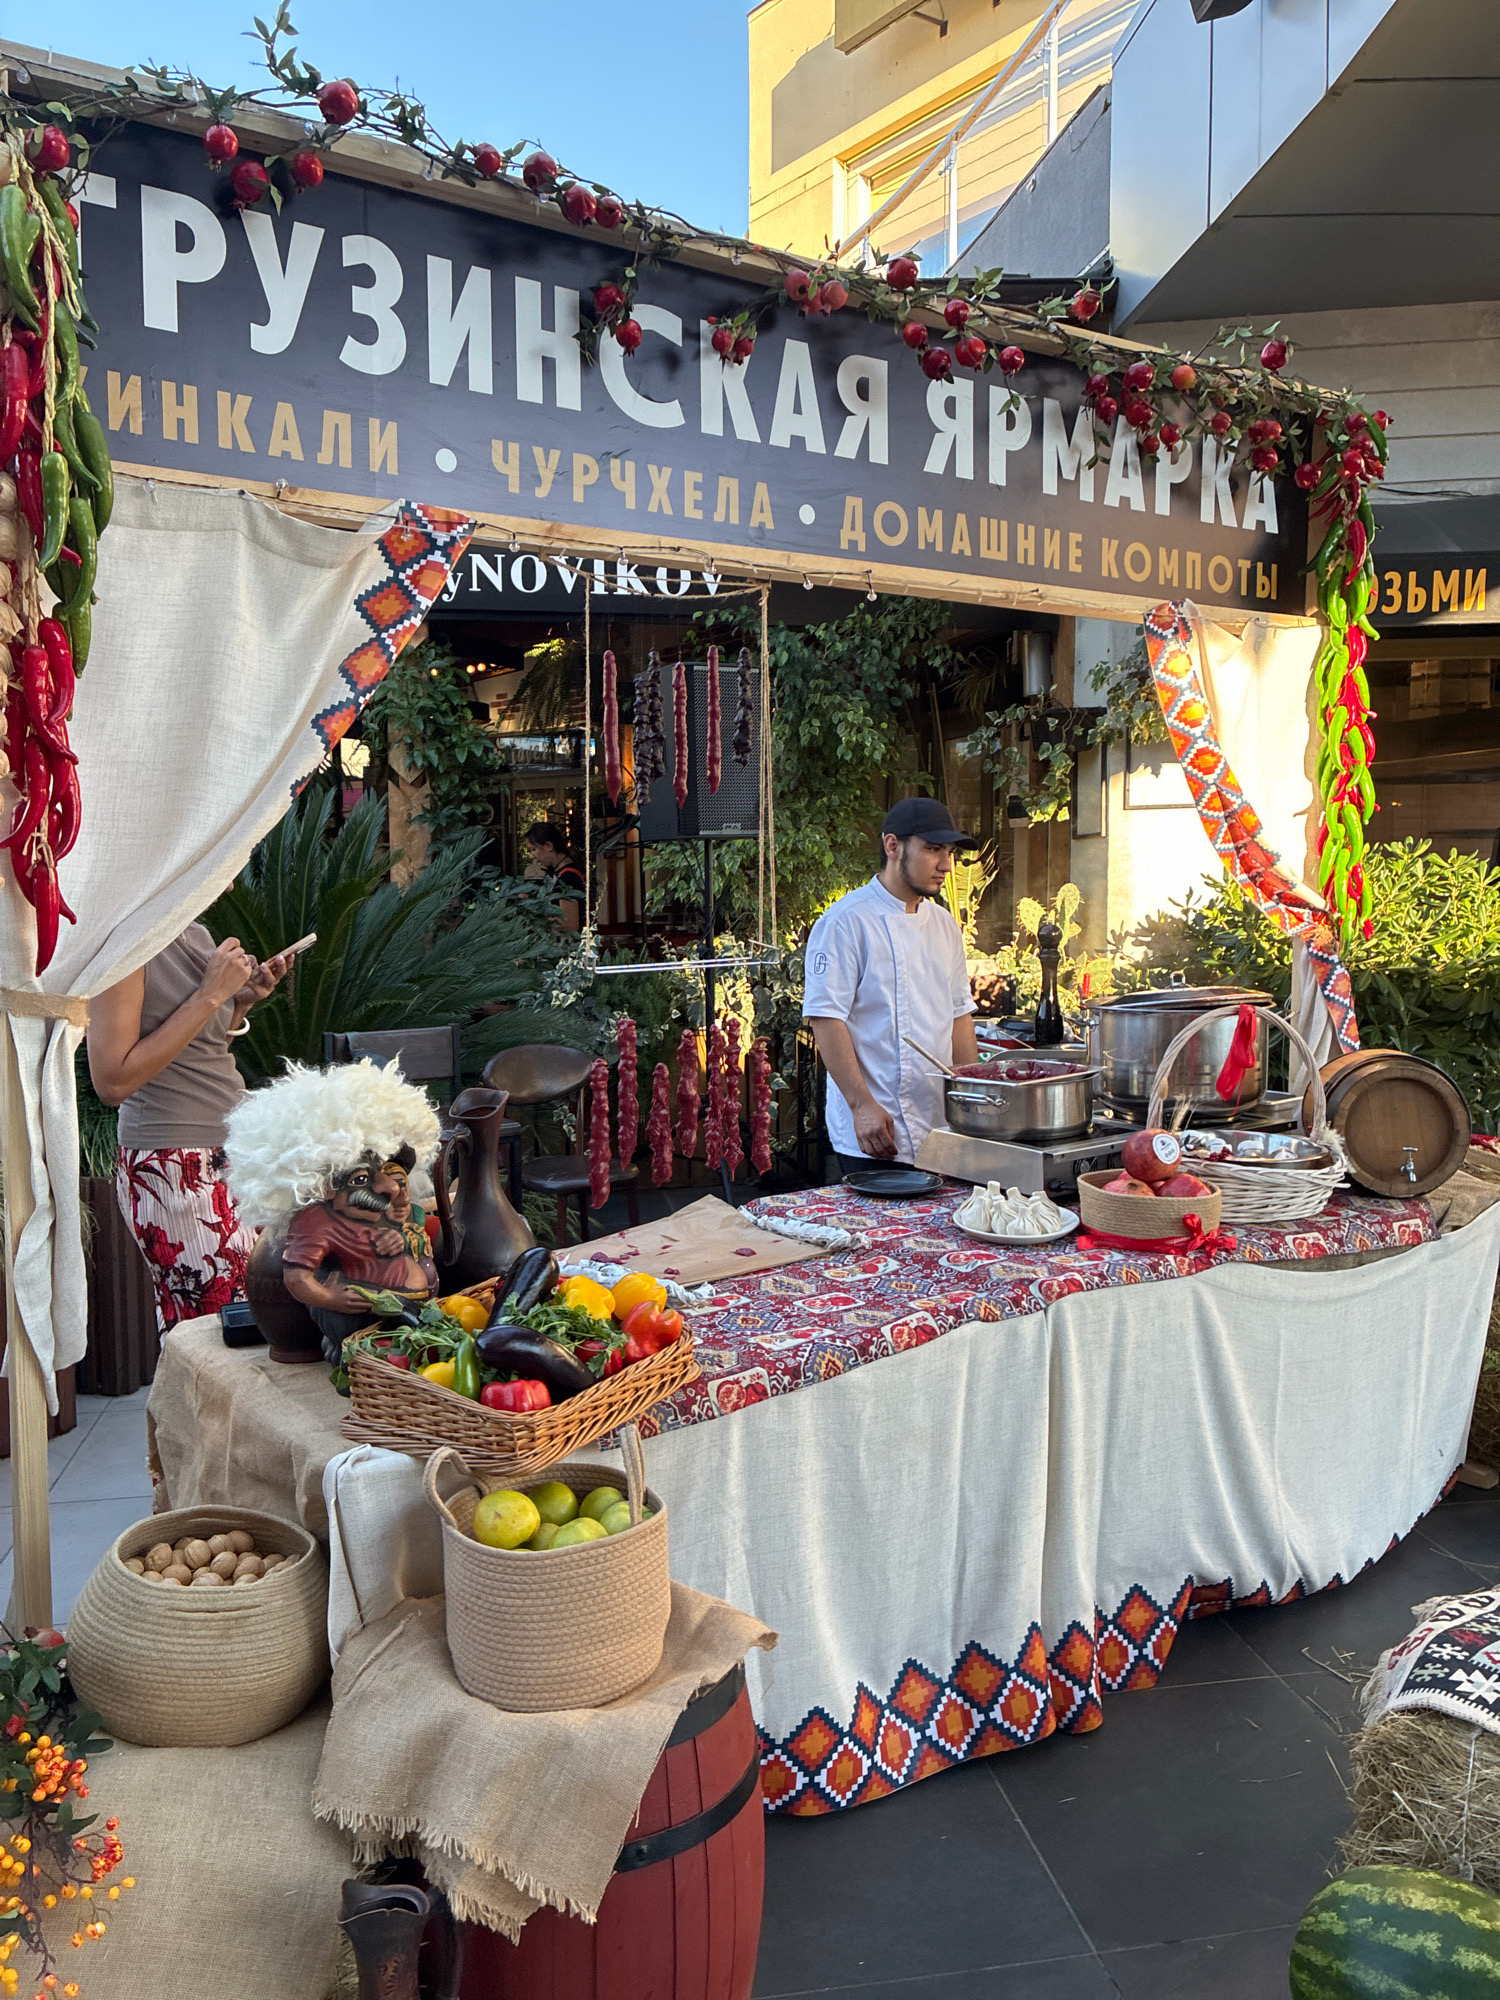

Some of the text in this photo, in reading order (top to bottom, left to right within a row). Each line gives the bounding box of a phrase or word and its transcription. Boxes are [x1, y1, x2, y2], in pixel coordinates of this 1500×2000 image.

[78, 365, 1278, 600] ИНКАЛИ ЧУРЧХЕЛА ДОМАШНИЕ КОМПОТЫ
[923, 375, 1279, 534] ЯРМАРКА
[1365, 567, 1487, 615] ЗЬМИ
